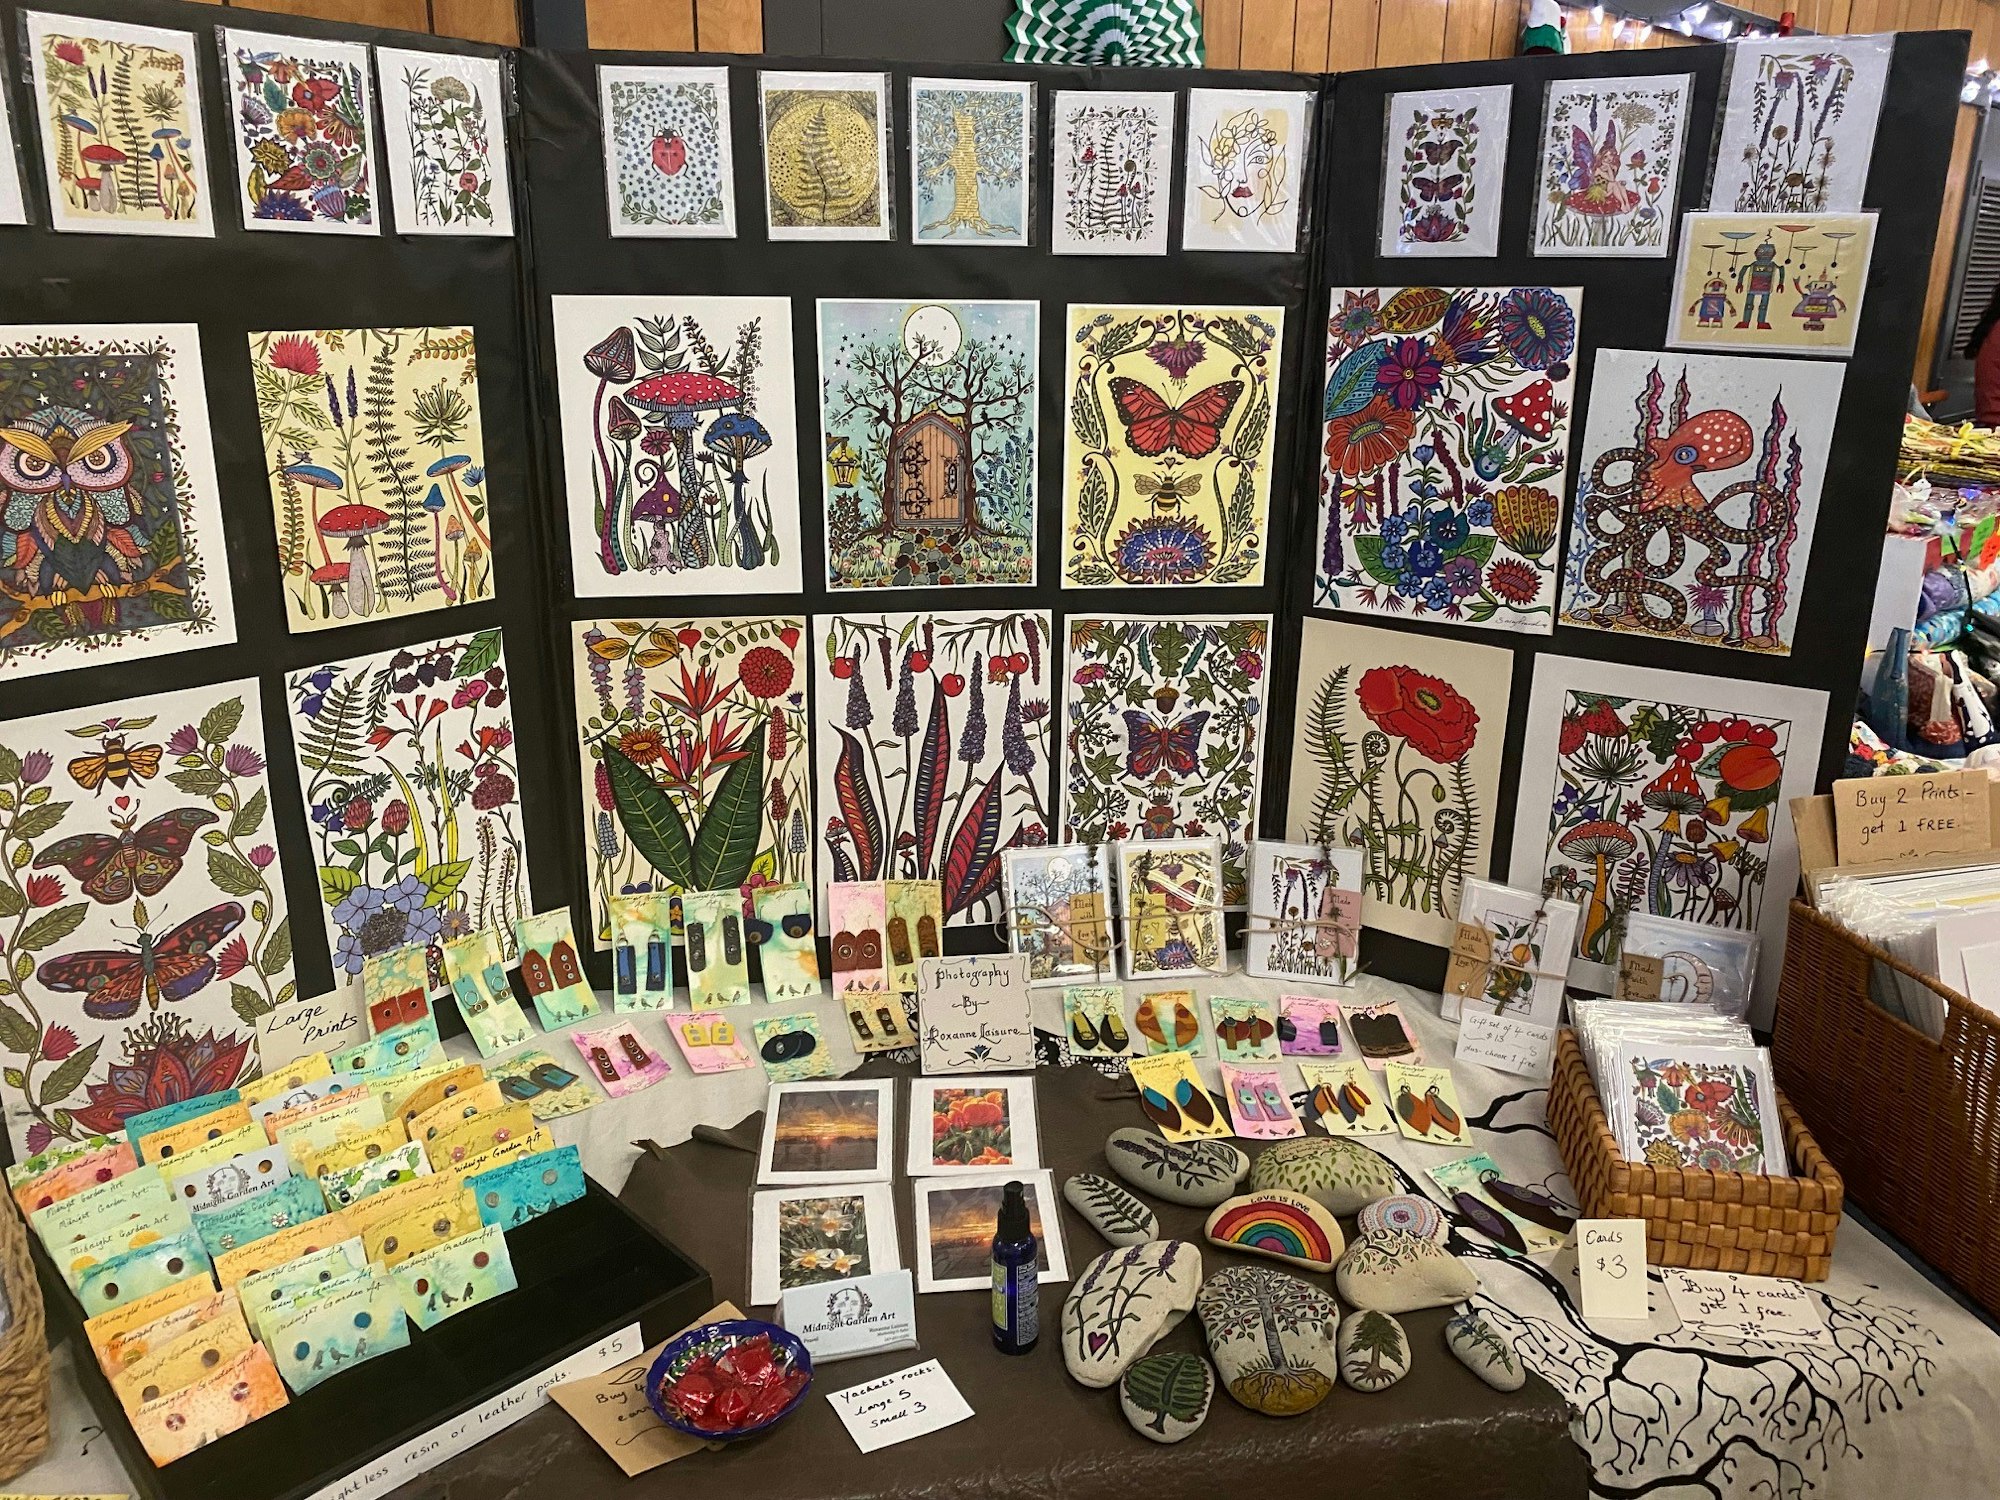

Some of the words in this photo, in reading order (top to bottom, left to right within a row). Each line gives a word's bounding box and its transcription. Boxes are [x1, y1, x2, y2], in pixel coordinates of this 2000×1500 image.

[1856, 789, 1886, 818] Buy
[1896, 787, 1908, 804] 2
[1921, 780, 1959, 800] Prints
[1861, 820, 1885, 845] get
[1898, 820, 1906, 833] 1
[1458, 928, 1482, 943] Made
[1629, 960, 1654, 975] Made
[267, 1005, 328, 1034] Large
[303, 1013, 358, 1044] Prints
[923, 1025, 977, 1051] Roxanne
[227, 1184, 258, 1200] Garden
[260, 1179, 275, 1190] Art
[1586, 1230, 1623, 1244] Cards
[1595, 1254, 1628, 1279] $3
[1682, 1279, 1725, 1301] Buy
[1731, 1284, 1750, 1299] 4
[1700, 1299, 1727, 1315] get
[1740, 1303, 1750, 1314] 1
[802, 1320, 844, 1335] Midnight
[846, 1315, 878, 1328] Garden
[880, 1312, 896, 1321] Art
[596, 1391, 627, 1405] Buy
[634, 1383, 645, 1393] 4
[898, 1389, 912, 1400] 5
[913, 1401, 927, 1413] 3
[404, 1441, 440, 1464] resin
[450, 1424, 467, 1439] or
[478, 1390, 527, 1423] leather
